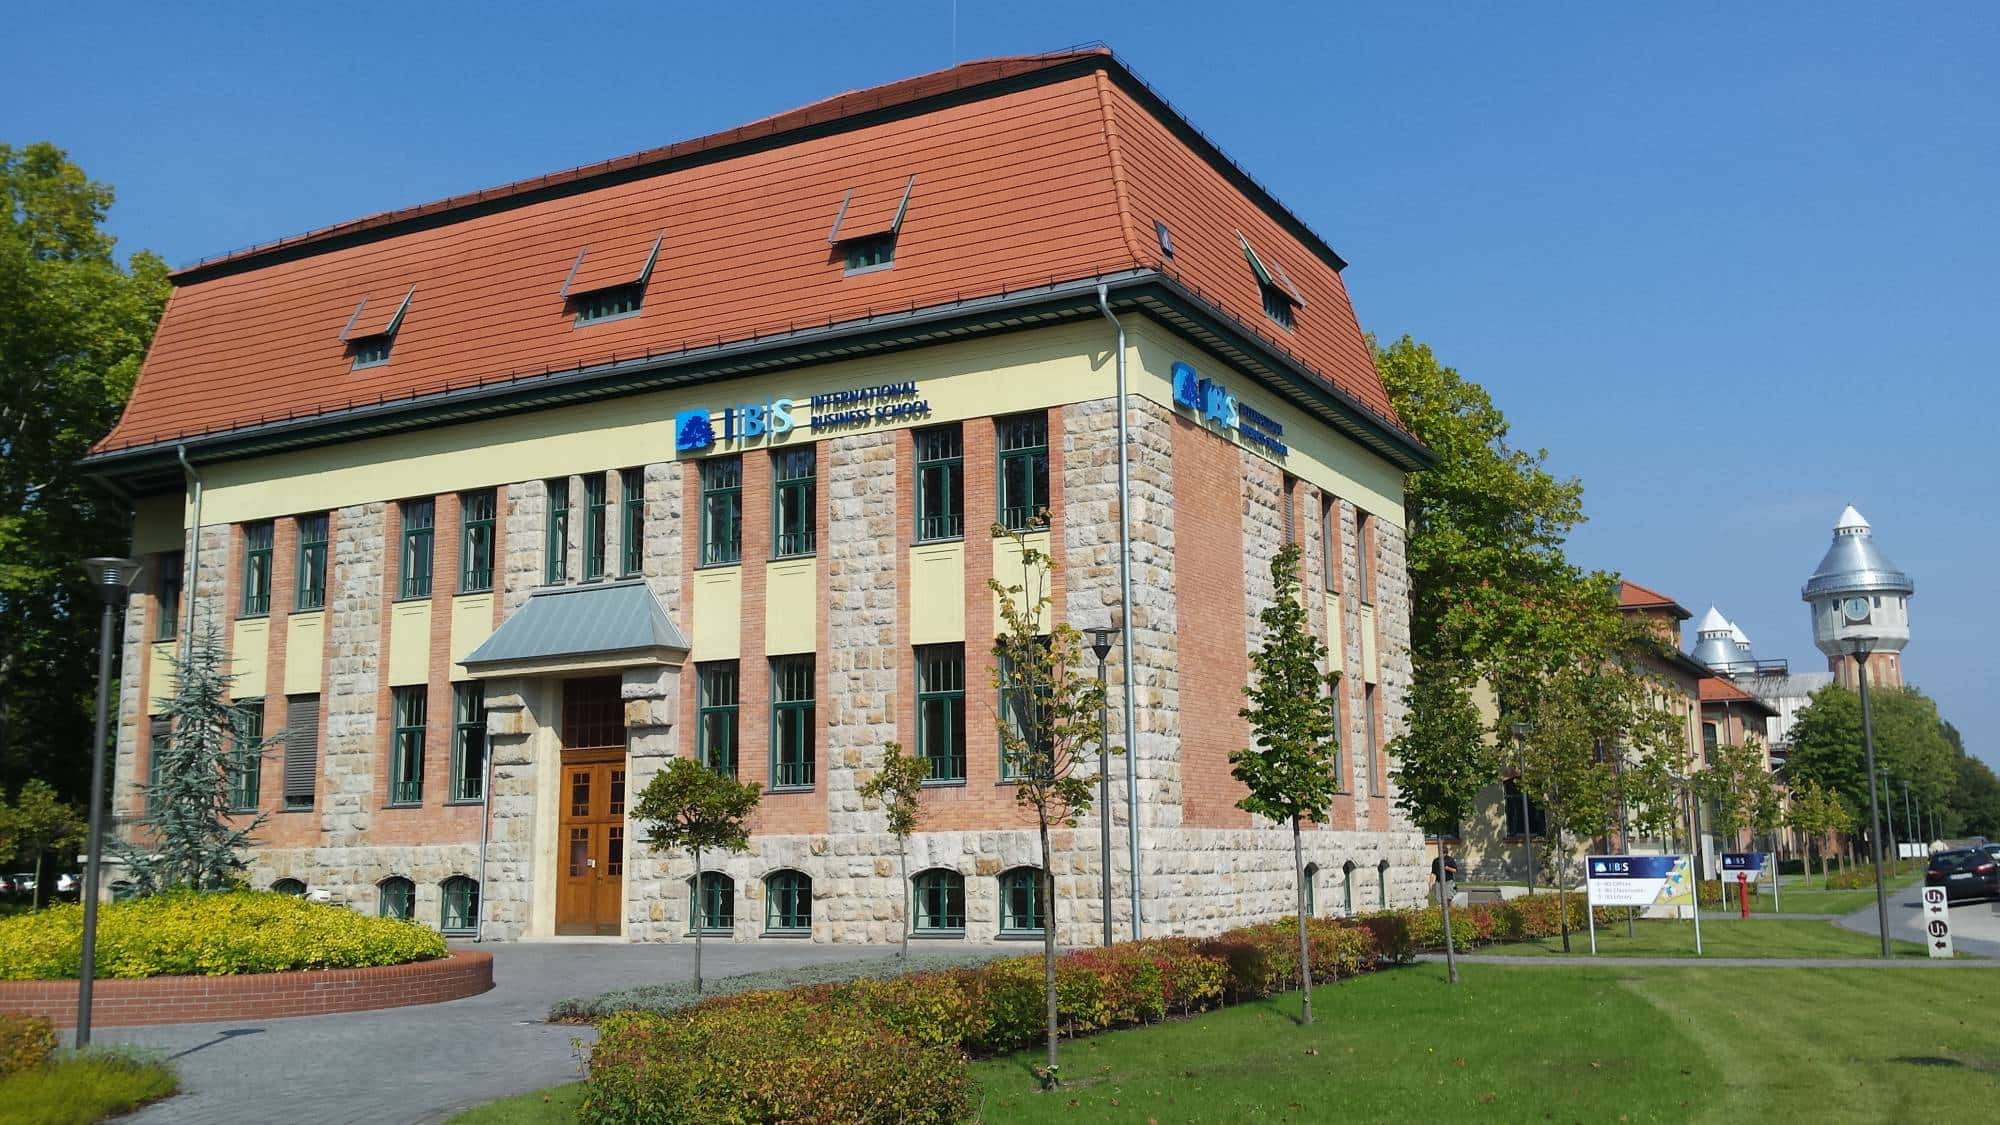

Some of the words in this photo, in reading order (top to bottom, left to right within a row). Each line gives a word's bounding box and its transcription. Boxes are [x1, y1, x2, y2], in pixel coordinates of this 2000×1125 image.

[810, 381, 920, 408] INTERNATIONAL
[810, 408, 874, 429] BUSINESS
[875, 400, 932, 419] SCHOOL
